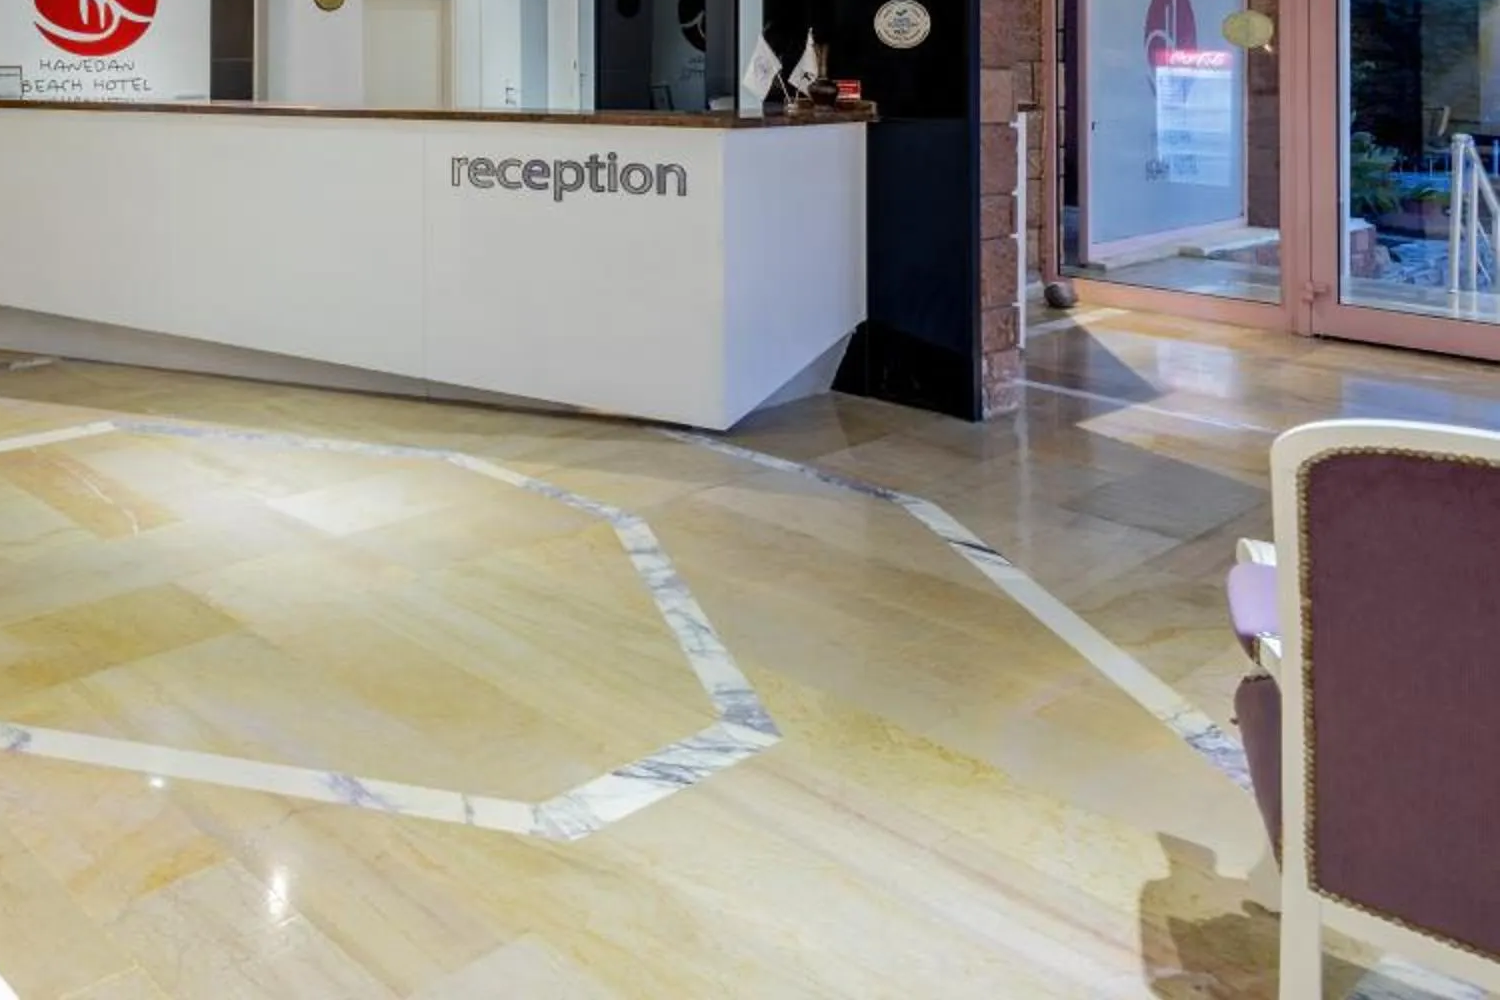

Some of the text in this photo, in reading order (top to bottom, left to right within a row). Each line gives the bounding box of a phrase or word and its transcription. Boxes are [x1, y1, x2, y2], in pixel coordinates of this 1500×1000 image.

[39, 58, 135, 73] HANEDAN
[22, 77, 152, 94] BEACH HOTEL
[451, 151, 688, 202] reception
